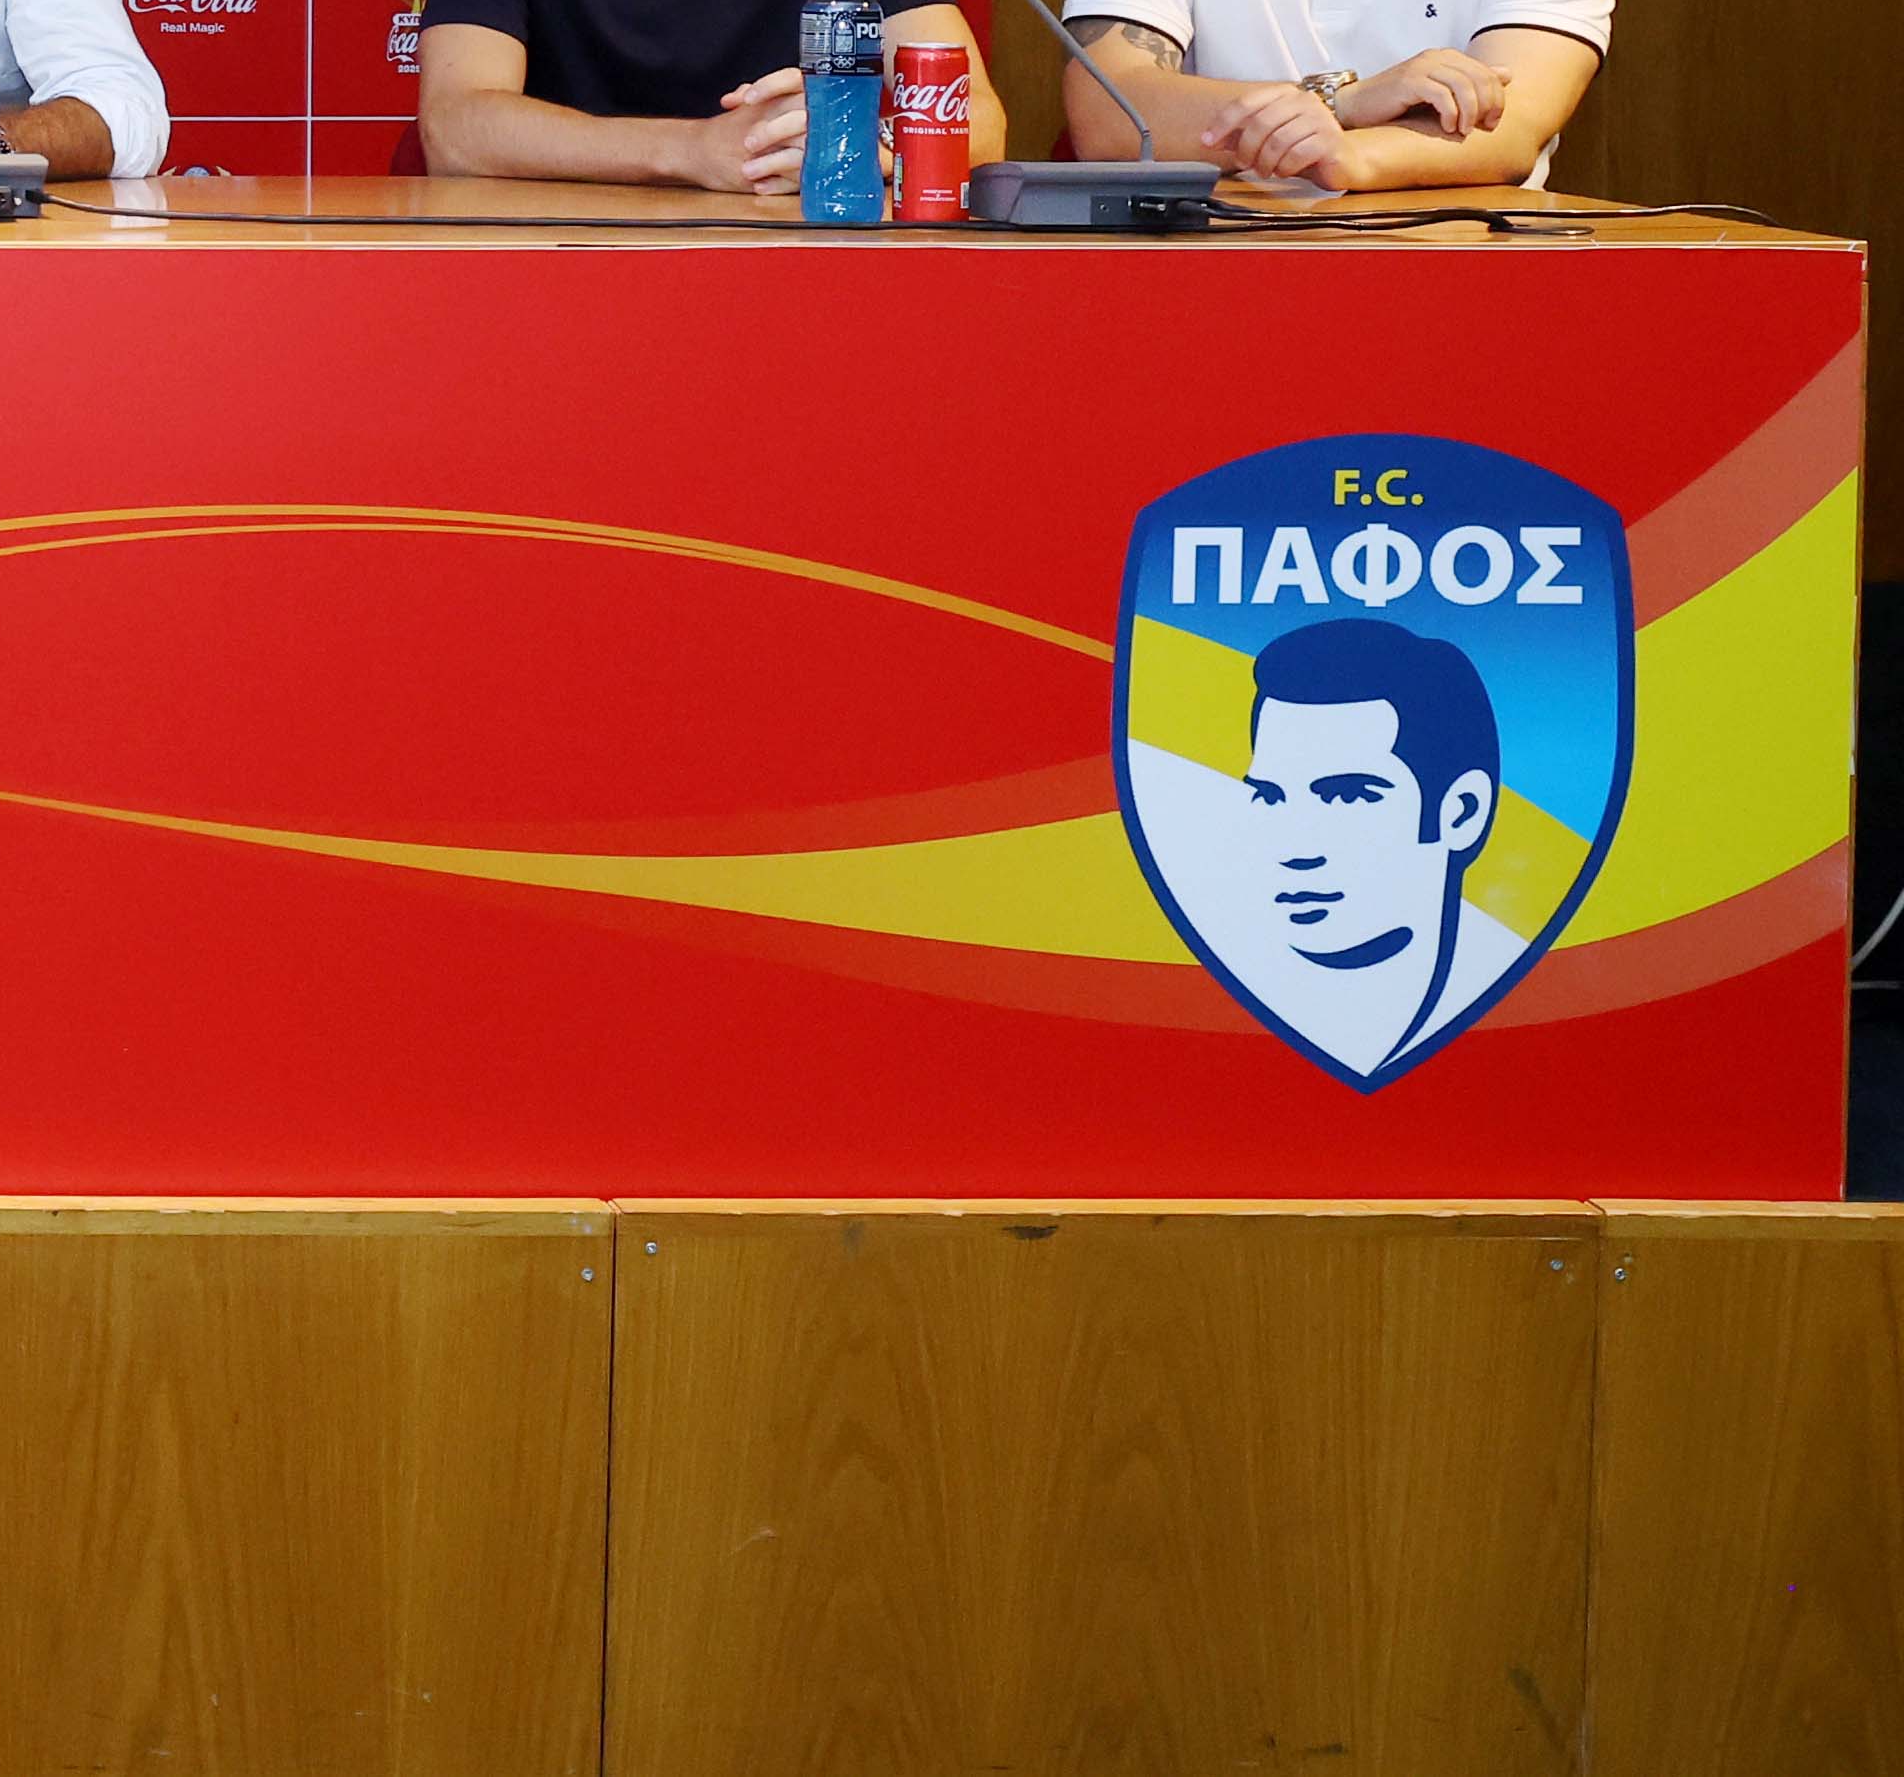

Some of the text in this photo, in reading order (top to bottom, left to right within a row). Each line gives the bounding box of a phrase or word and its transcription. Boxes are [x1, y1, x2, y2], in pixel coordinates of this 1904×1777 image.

[161, 22, 225, 35] Real Magic
[903, 126, 947, 135] ORIGINAL
[1333, 469, 1424, 506] F.C.
[1171, 523, 1583, 608] ΠΑΦΟΣ
